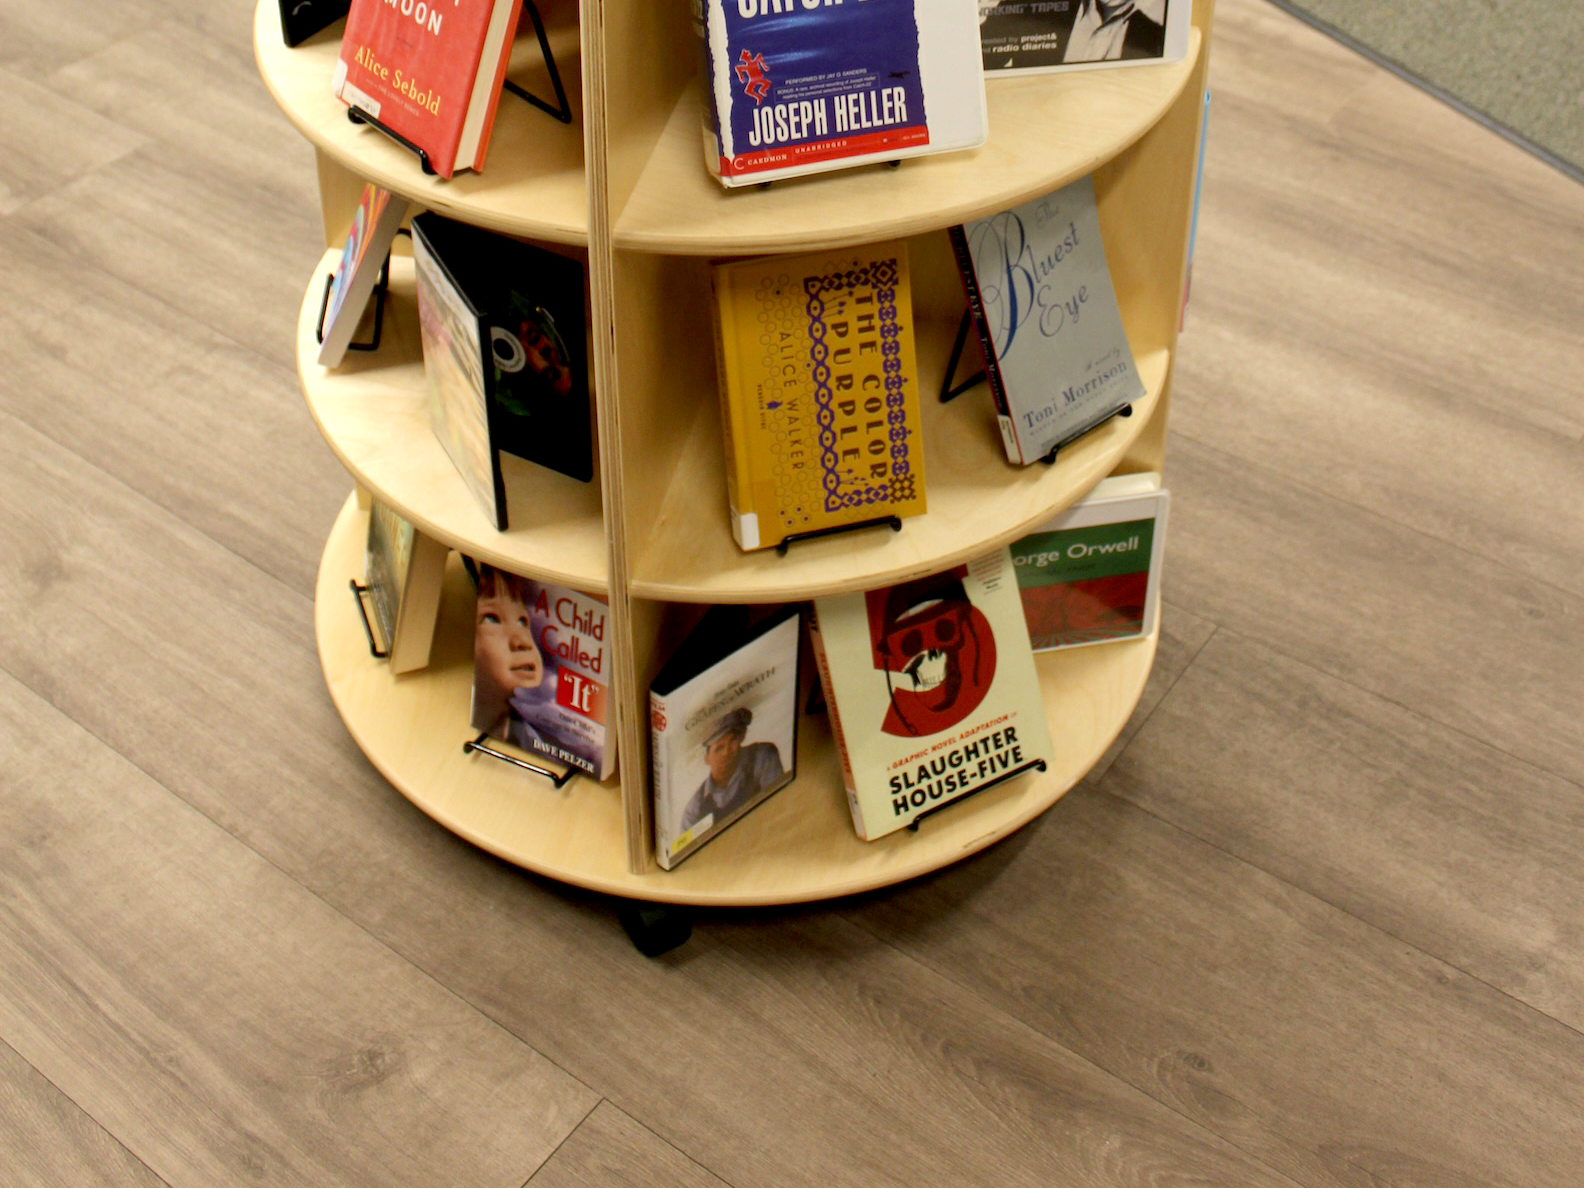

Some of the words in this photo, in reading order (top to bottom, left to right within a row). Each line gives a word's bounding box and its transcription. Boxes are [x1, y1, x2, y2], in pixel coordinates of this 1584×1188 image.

[992, 44, 1019, 53] radio
[1021, 42, 1057, 52] diaries
[353, 44, 389, 81] Alice
[392, 70, 441, 116] Sebold
[785, 75, 817, 85] PERFORMED
[842, 68, 867, 77] SANDERS
[748, 99, 828, 147] JOSEPH
[833, 86, 907, 133] HELLER
[747, 154, 787, 166] CAEDMON
[795, 141, 848, 154] UNABRIDGED
[967, 210, 1081, 363] Bluest
[1037, 284, 1089, 338] Eye
[854, 292, 878, 357] THE
[778, 331, 798, 388] ALICE
[830, 321, 861, 462] PURPLE
[1023, 397, 1060, 430] Toni
[1061, 361, 1128, 403] Morrison
[785, 398, 805, 471] WALKER
[862, 374, 888, 480] COLOR
[1013, 550, 1060, 568] orge
[1067, 536, 1139, 559] Orwell
[535, 589, 549, 617] A
[555, 597, 604, 641] Child
[541, 626, 603, 674] Called
[533, 738, 558, 757] DAVE
[559, 749, 595, 774] PELZER
[889, 726, 1018, 795] SLAUGHTER
[892, 748, 929, 770] GRAPHIC
[931, 737, 957, 753] NOVEL
[959, 713, 1009, 741] ADAPTATION
[892, 745, 1024, 816] HOUSE-FIVE
